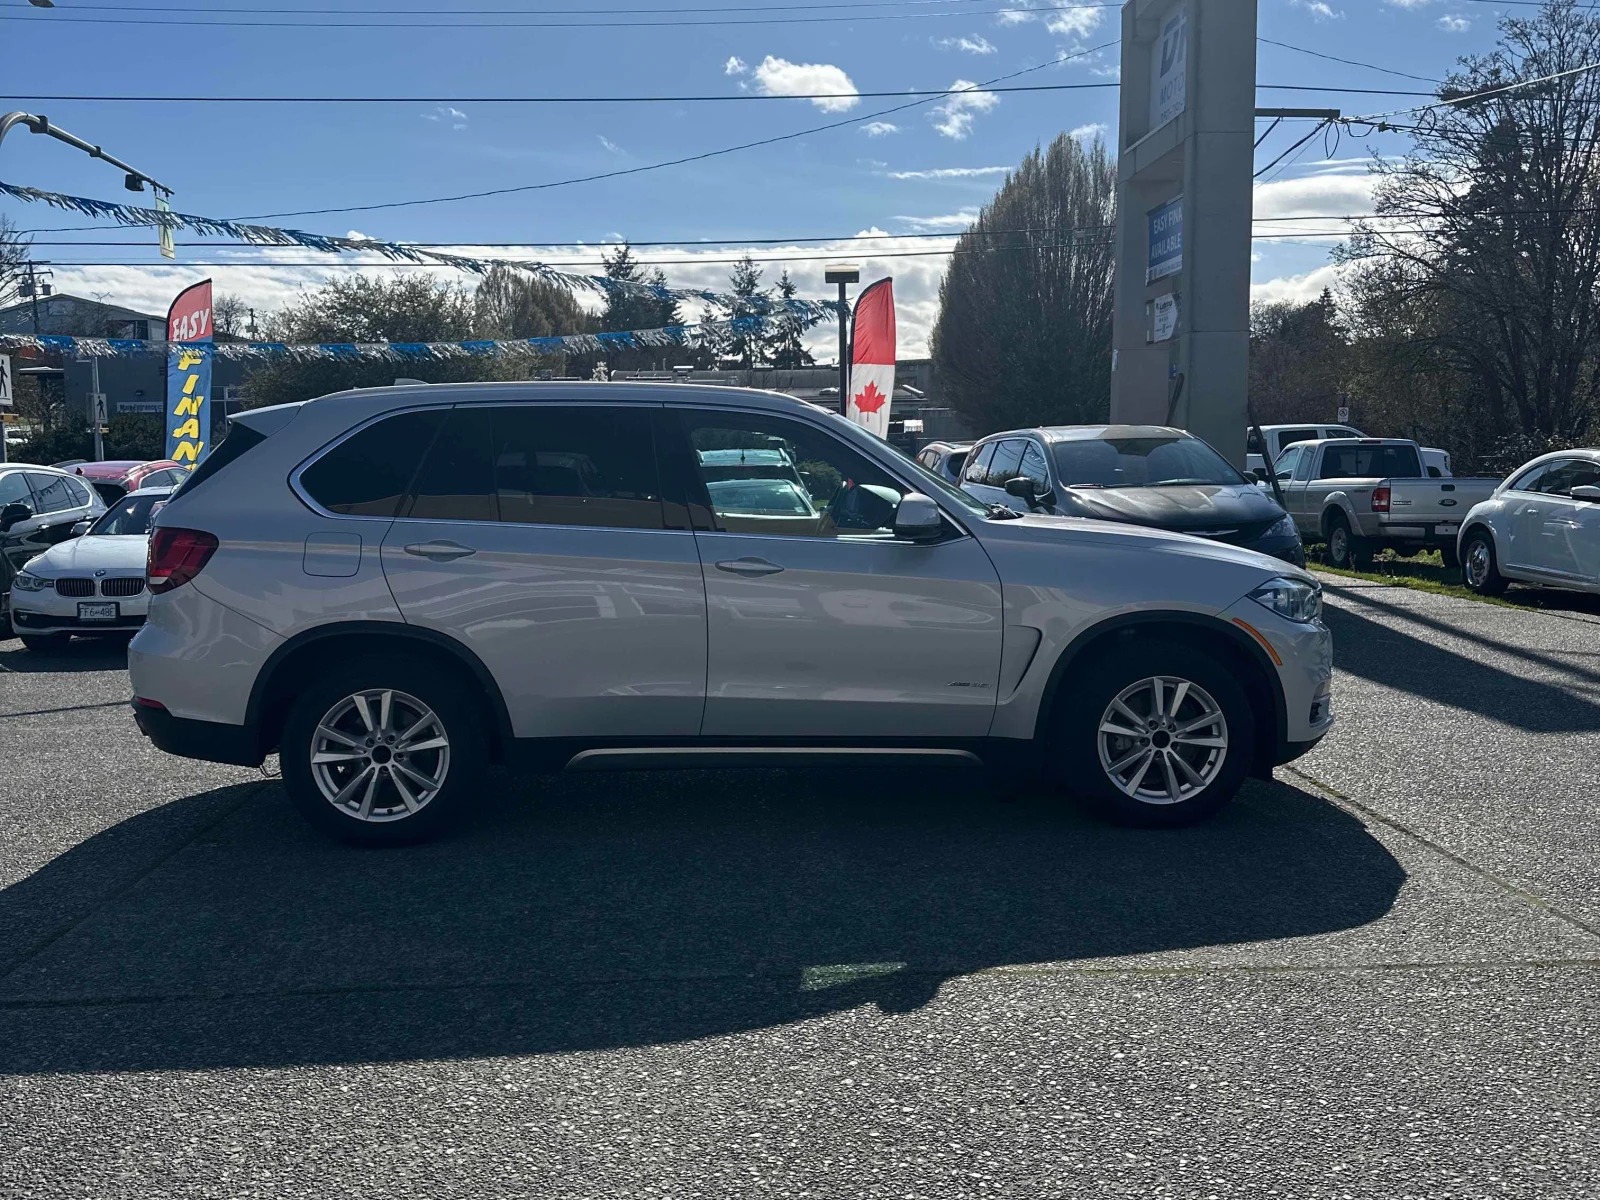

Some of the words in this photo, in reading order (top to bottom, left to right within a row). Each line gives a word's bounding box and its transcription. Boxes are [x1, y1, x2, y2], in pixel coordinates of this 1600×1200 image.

[1153, 213, 1168, 234] EASY
[1168, 206, 1183, 227] FINA
[1151, 232, 1182, 260] AVAILABLE
[172, 308, 210, 342] EASY
[172, 350, 204, 471] FINAN
